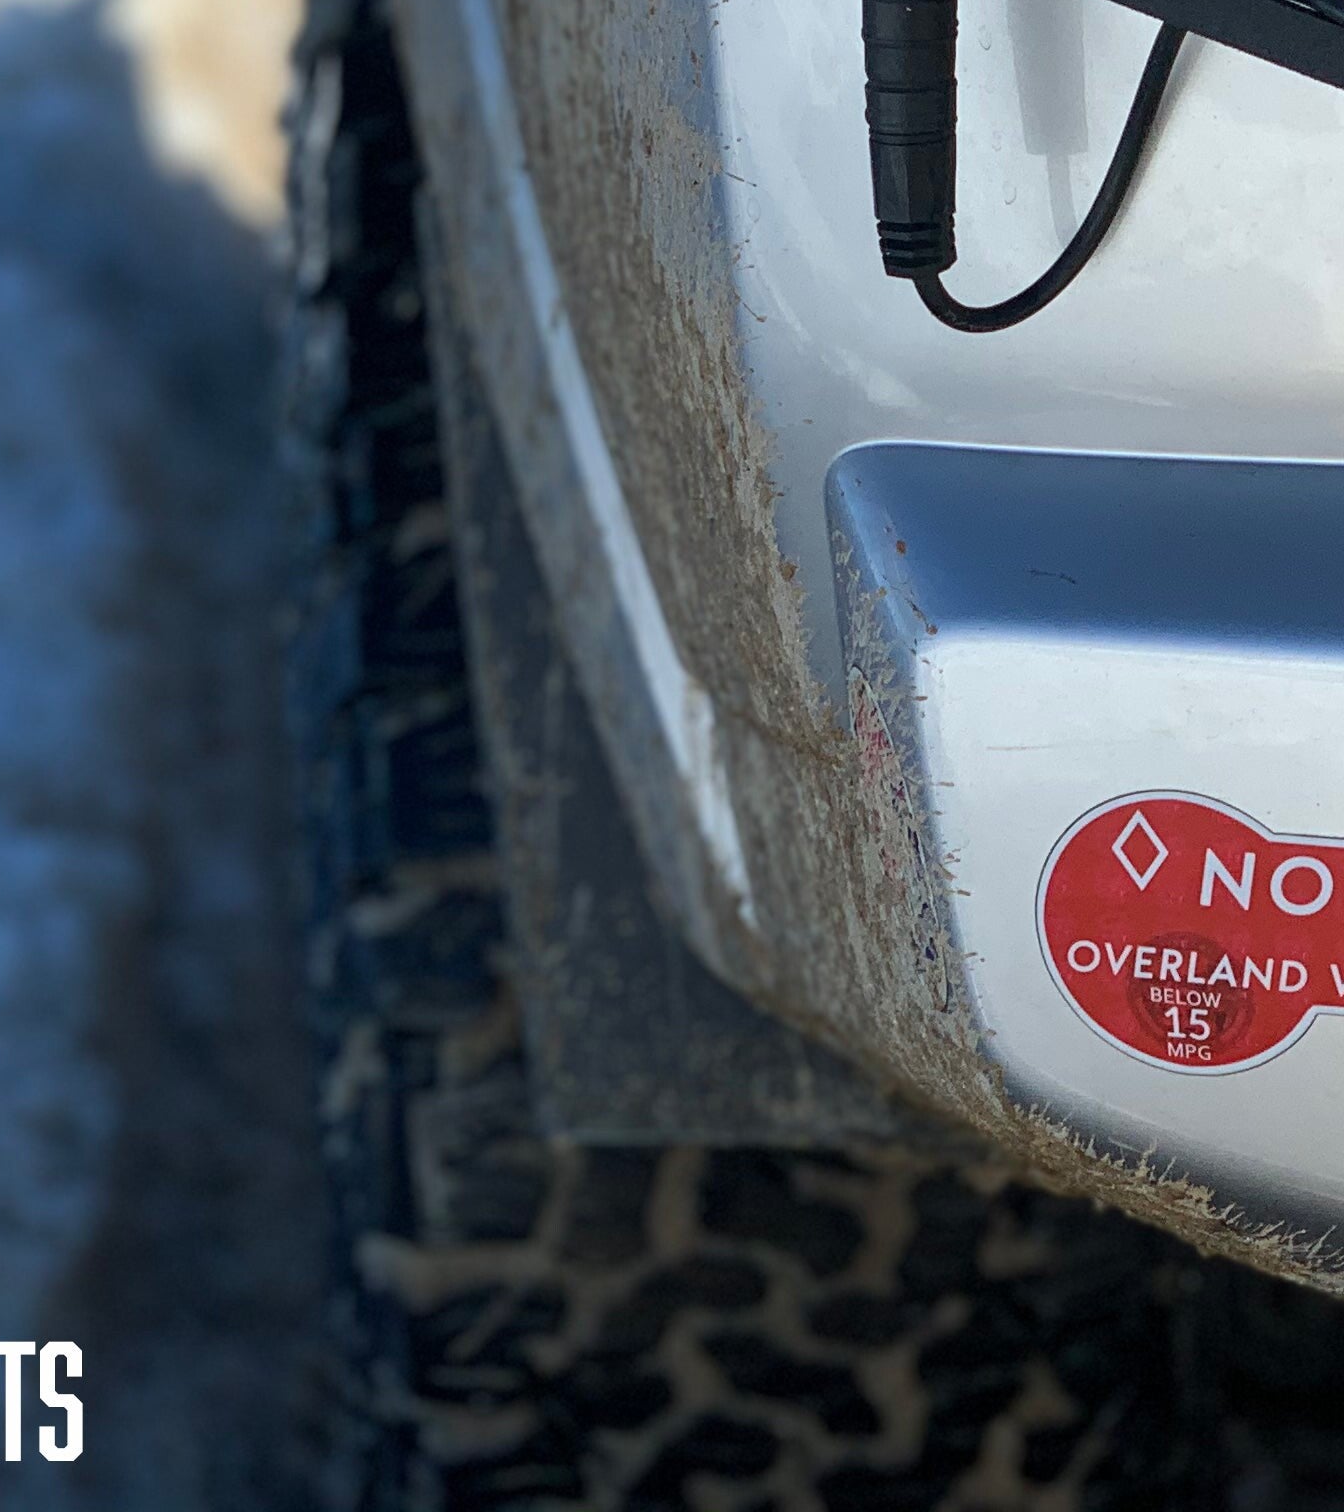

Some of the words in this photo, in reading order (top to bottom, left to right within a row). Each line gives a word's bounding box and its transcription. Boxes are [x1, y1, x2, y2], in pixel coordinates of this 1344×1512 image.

[1199, 847, 1334, 916] NO
[1067, 940, 1308, 993] OVERLAND
[1150, 986, 1221, 1008] BELOW
[1164, 1006, 1211, 1041] 15
[1167, 1041, 1212, 1061] MPG
